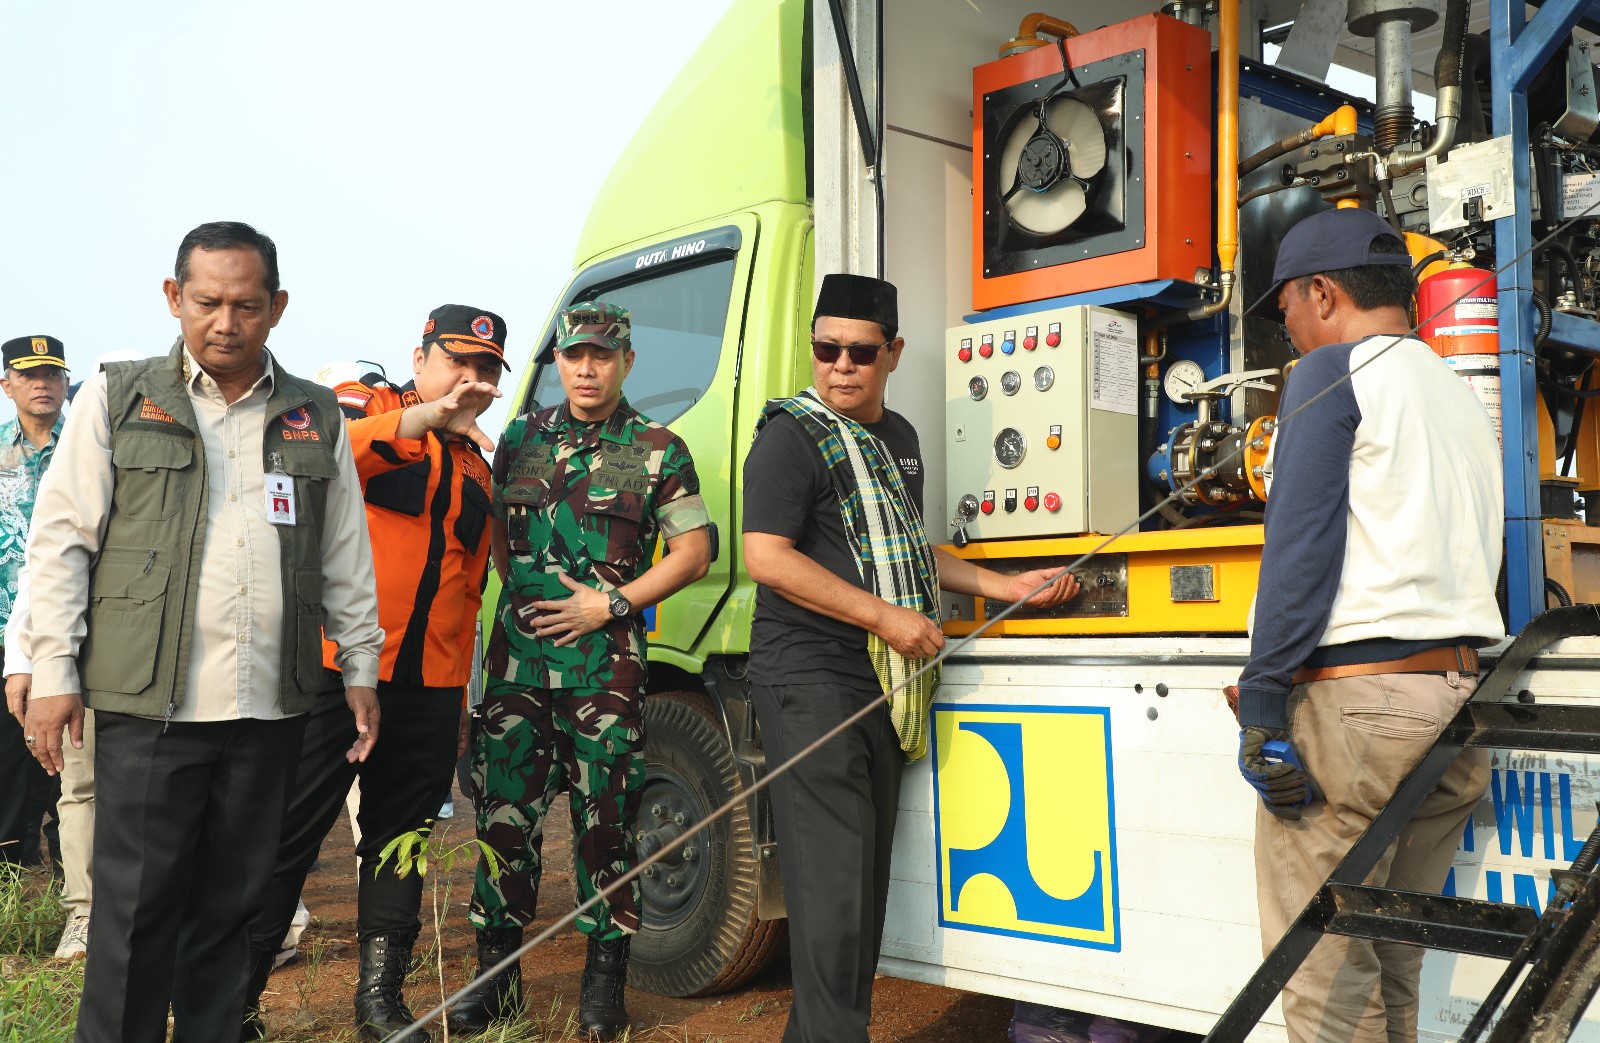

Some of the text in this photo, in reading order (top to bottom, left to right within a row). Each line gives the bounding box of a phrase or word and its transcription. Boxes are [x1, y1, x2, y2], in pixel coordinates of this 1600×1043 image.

[1467, 187, 1485, 196] WINCH
[635, 239, 706, 269] DUTA HINO
[282, 430, 320, 441] BNPB
[513, 465, 546, 477] RONY
[597, 473, 644, 491] TNI AD
[1491, 768, 1600, 864] WIL
